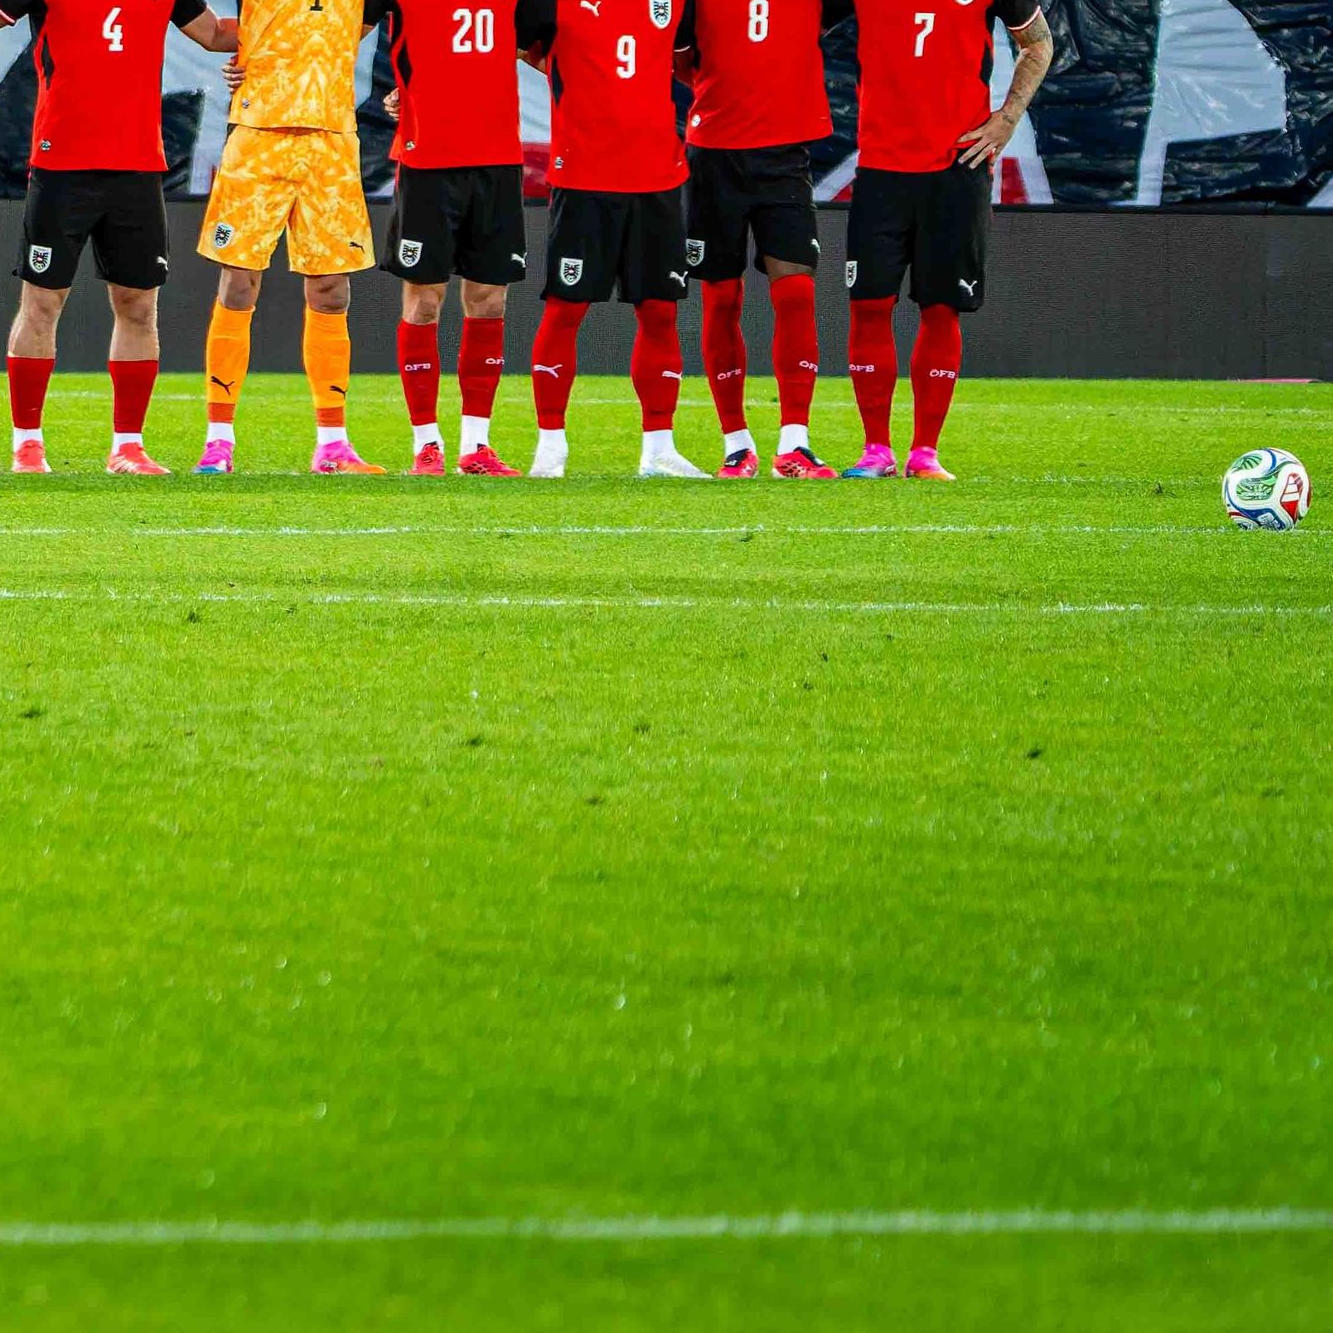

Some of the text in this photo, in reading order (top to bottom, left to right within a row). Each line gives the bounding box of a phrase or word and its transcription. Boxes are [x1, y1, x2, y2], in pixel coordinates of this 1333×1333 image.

[102, 7, 124, 52] 4
[451, 8, 495, 54] 20
[913, 12, 936, 58] 7
[615, 34, 637, 80] 9
